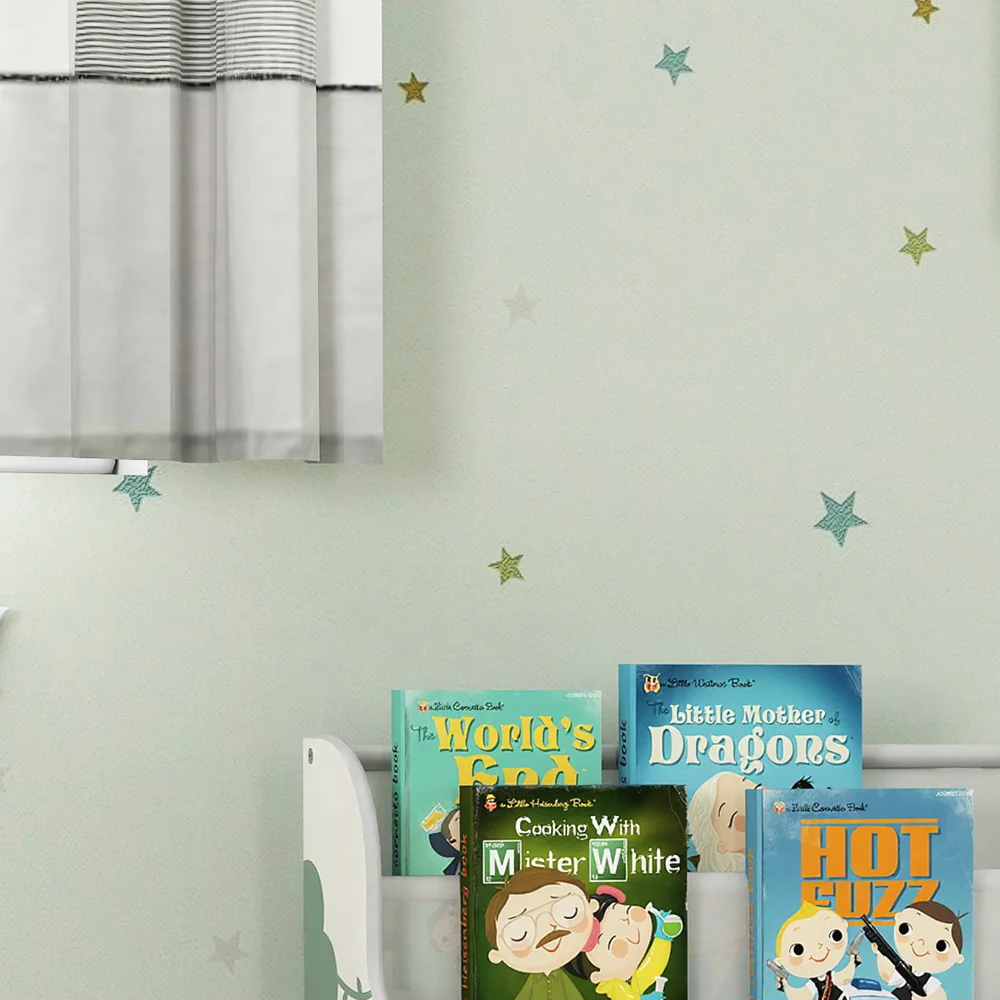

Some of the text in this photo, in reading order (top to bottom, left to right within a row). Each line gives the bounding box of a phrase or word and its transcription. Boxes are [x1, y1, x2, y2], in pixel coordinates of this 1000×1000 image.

[410, 715, 597, 752] The World's
[647, 701, 841, 727] The Little Mother of
[619, 719, 627, 767] book
[648, 725, 852, 775] Dragons
[391, 744, 399, 784] book
[515, 815, 641, 840] Cooking With
[488, 847, 586, 877] Mister
[592, 846, 681, 876] White
[800, 826, 942, 879] HOT
[801, 880, 942, 919] FUZZ
[461, 885, 470, 989] Heisenberg
